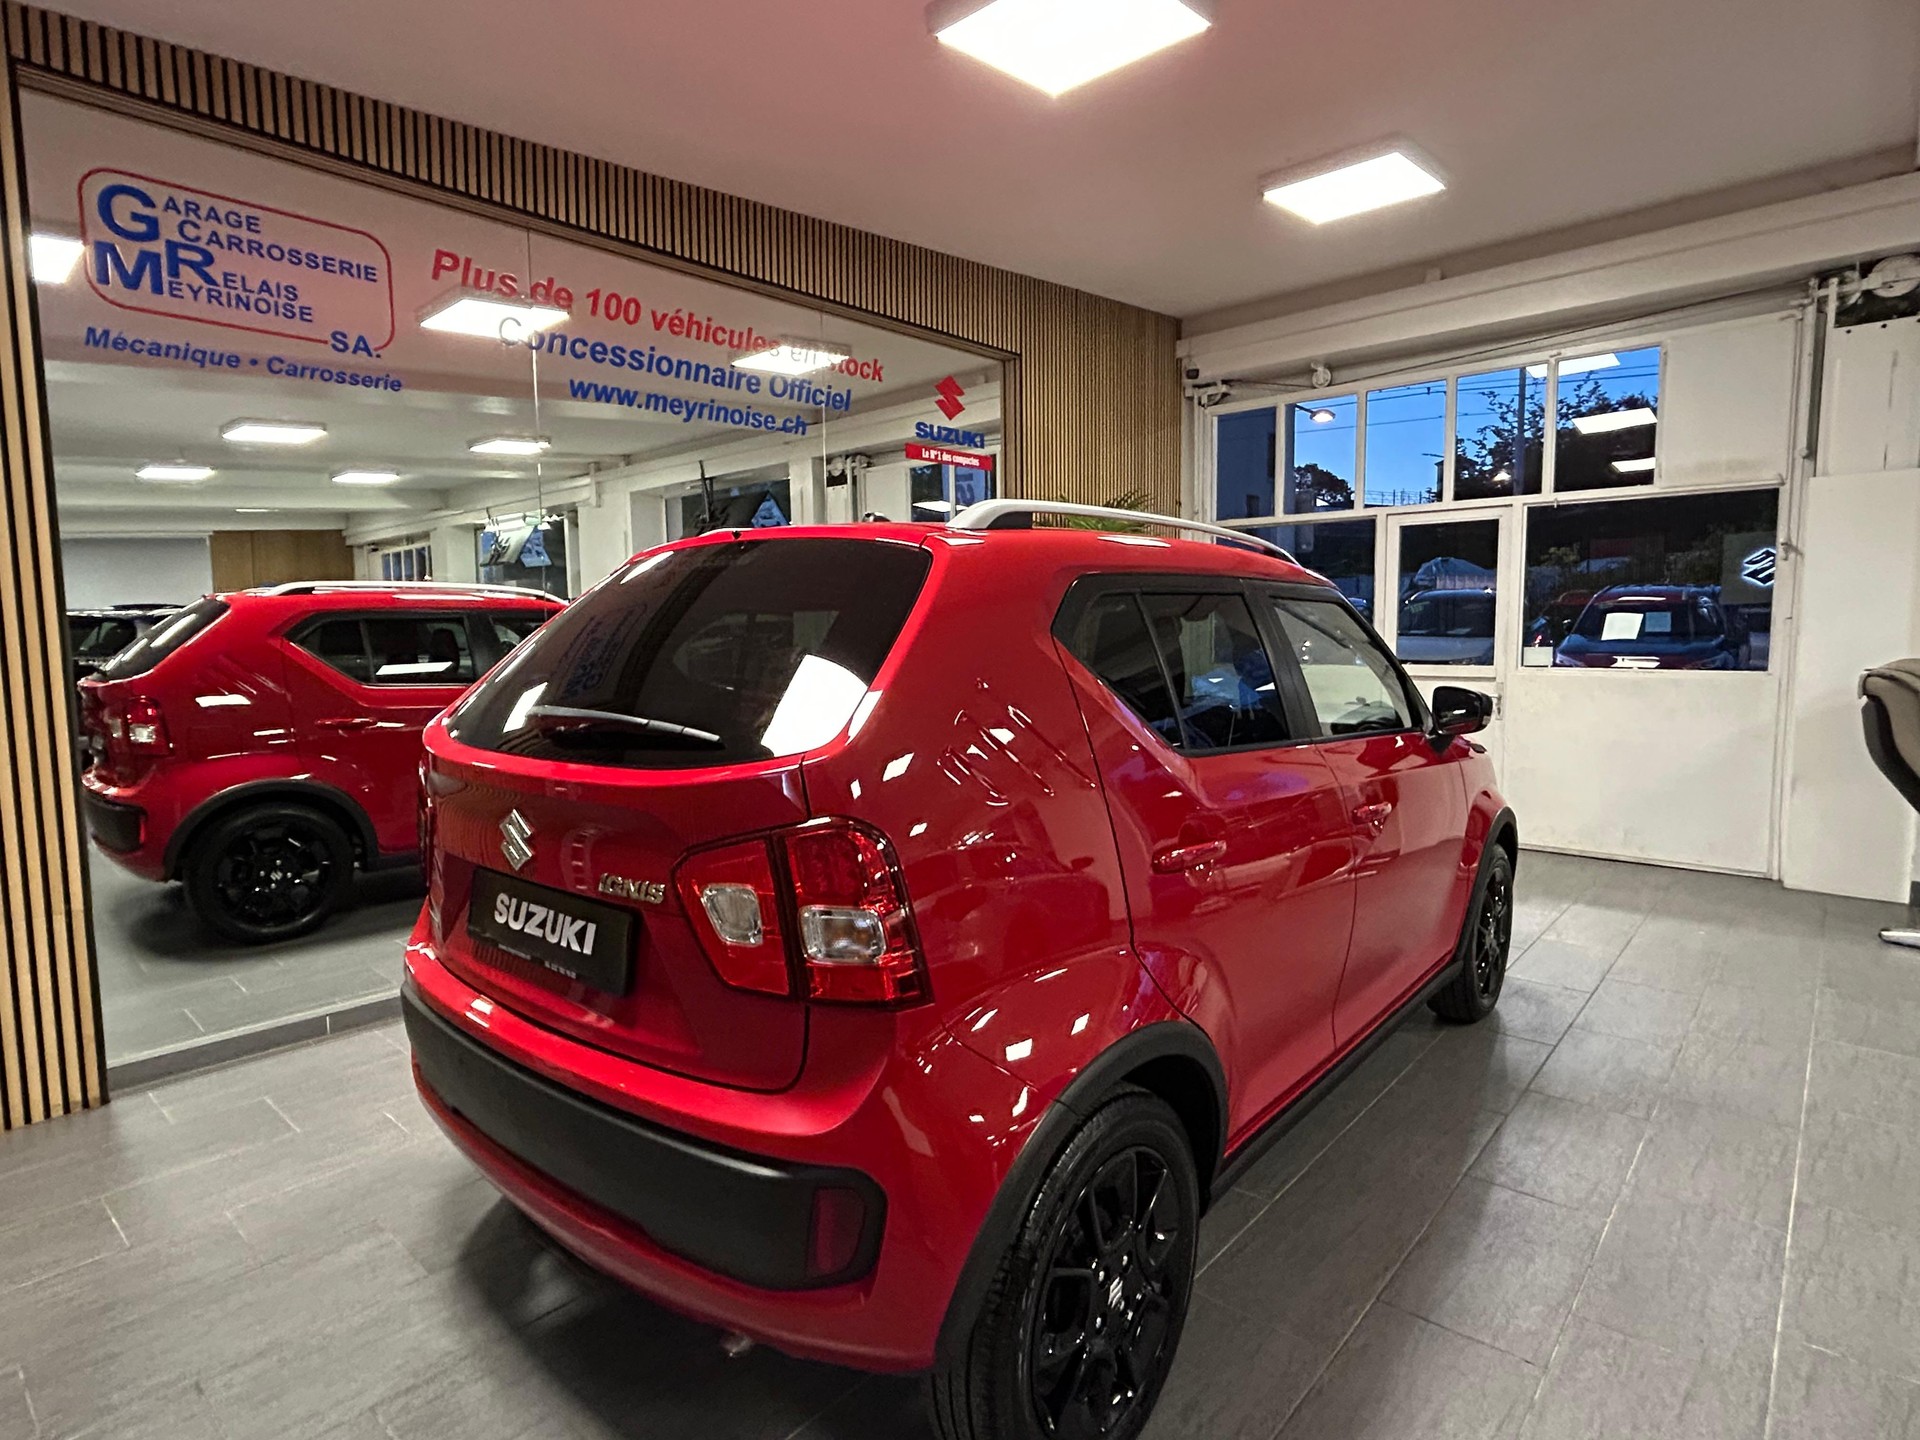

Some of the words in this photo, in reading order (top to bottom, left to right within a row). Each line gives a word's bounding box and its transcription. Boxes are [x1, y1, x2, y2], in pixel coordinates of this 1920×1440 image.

[97, 184, 262, 242] GARAGE
[93, 240, 313, 322] MEYRINOISE
[164, 239, 299, 302] RELAIS
[177, 219, 378, 283] CARROSSERIE
[432, 249, 518, 298] Plus
[529, 276, 574, 309] de
[586, 287, 642, 326] 100
[651, 308, 781, 358] véhicules
[84, 326, 241, 369] Mécanique
[266, 355, 403, 392] Carrosserie
[499, 317, 761, 394] Concessionnaire
[769, 375, 852, 411] Officiel
[568, 378, 808, 436] www.meyrinoise.ch
[915, 421, 985, 449] SUZUKI
[598, 873, 666, 904] IGNIS
[493, 892, 597, 956] SUZUKI
